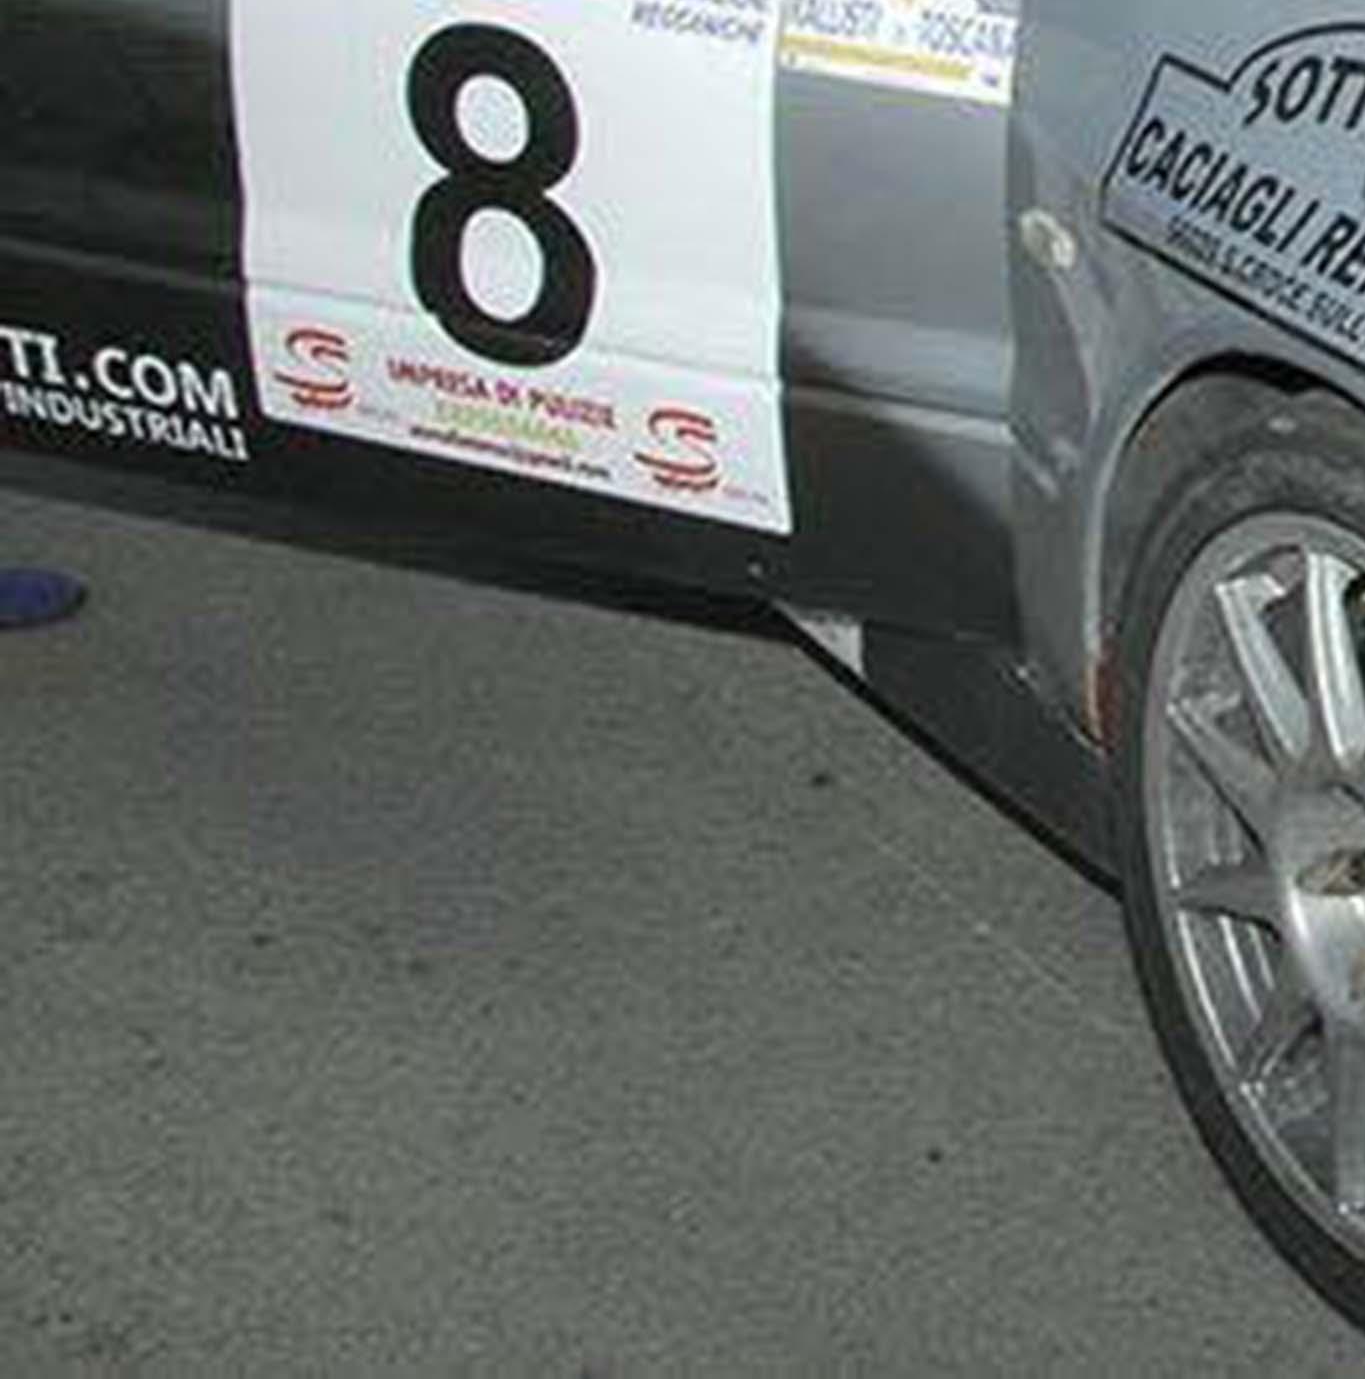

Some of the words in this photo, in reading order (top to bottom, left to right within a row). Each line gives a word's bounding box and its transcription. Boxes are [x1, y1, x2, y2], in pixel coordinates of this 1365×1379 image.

[405, 22, 600, 369] 8
[1125, 121, 1323, 257] CACIAGLI
[2, 380, 249, 462] INDUSTRIALI
